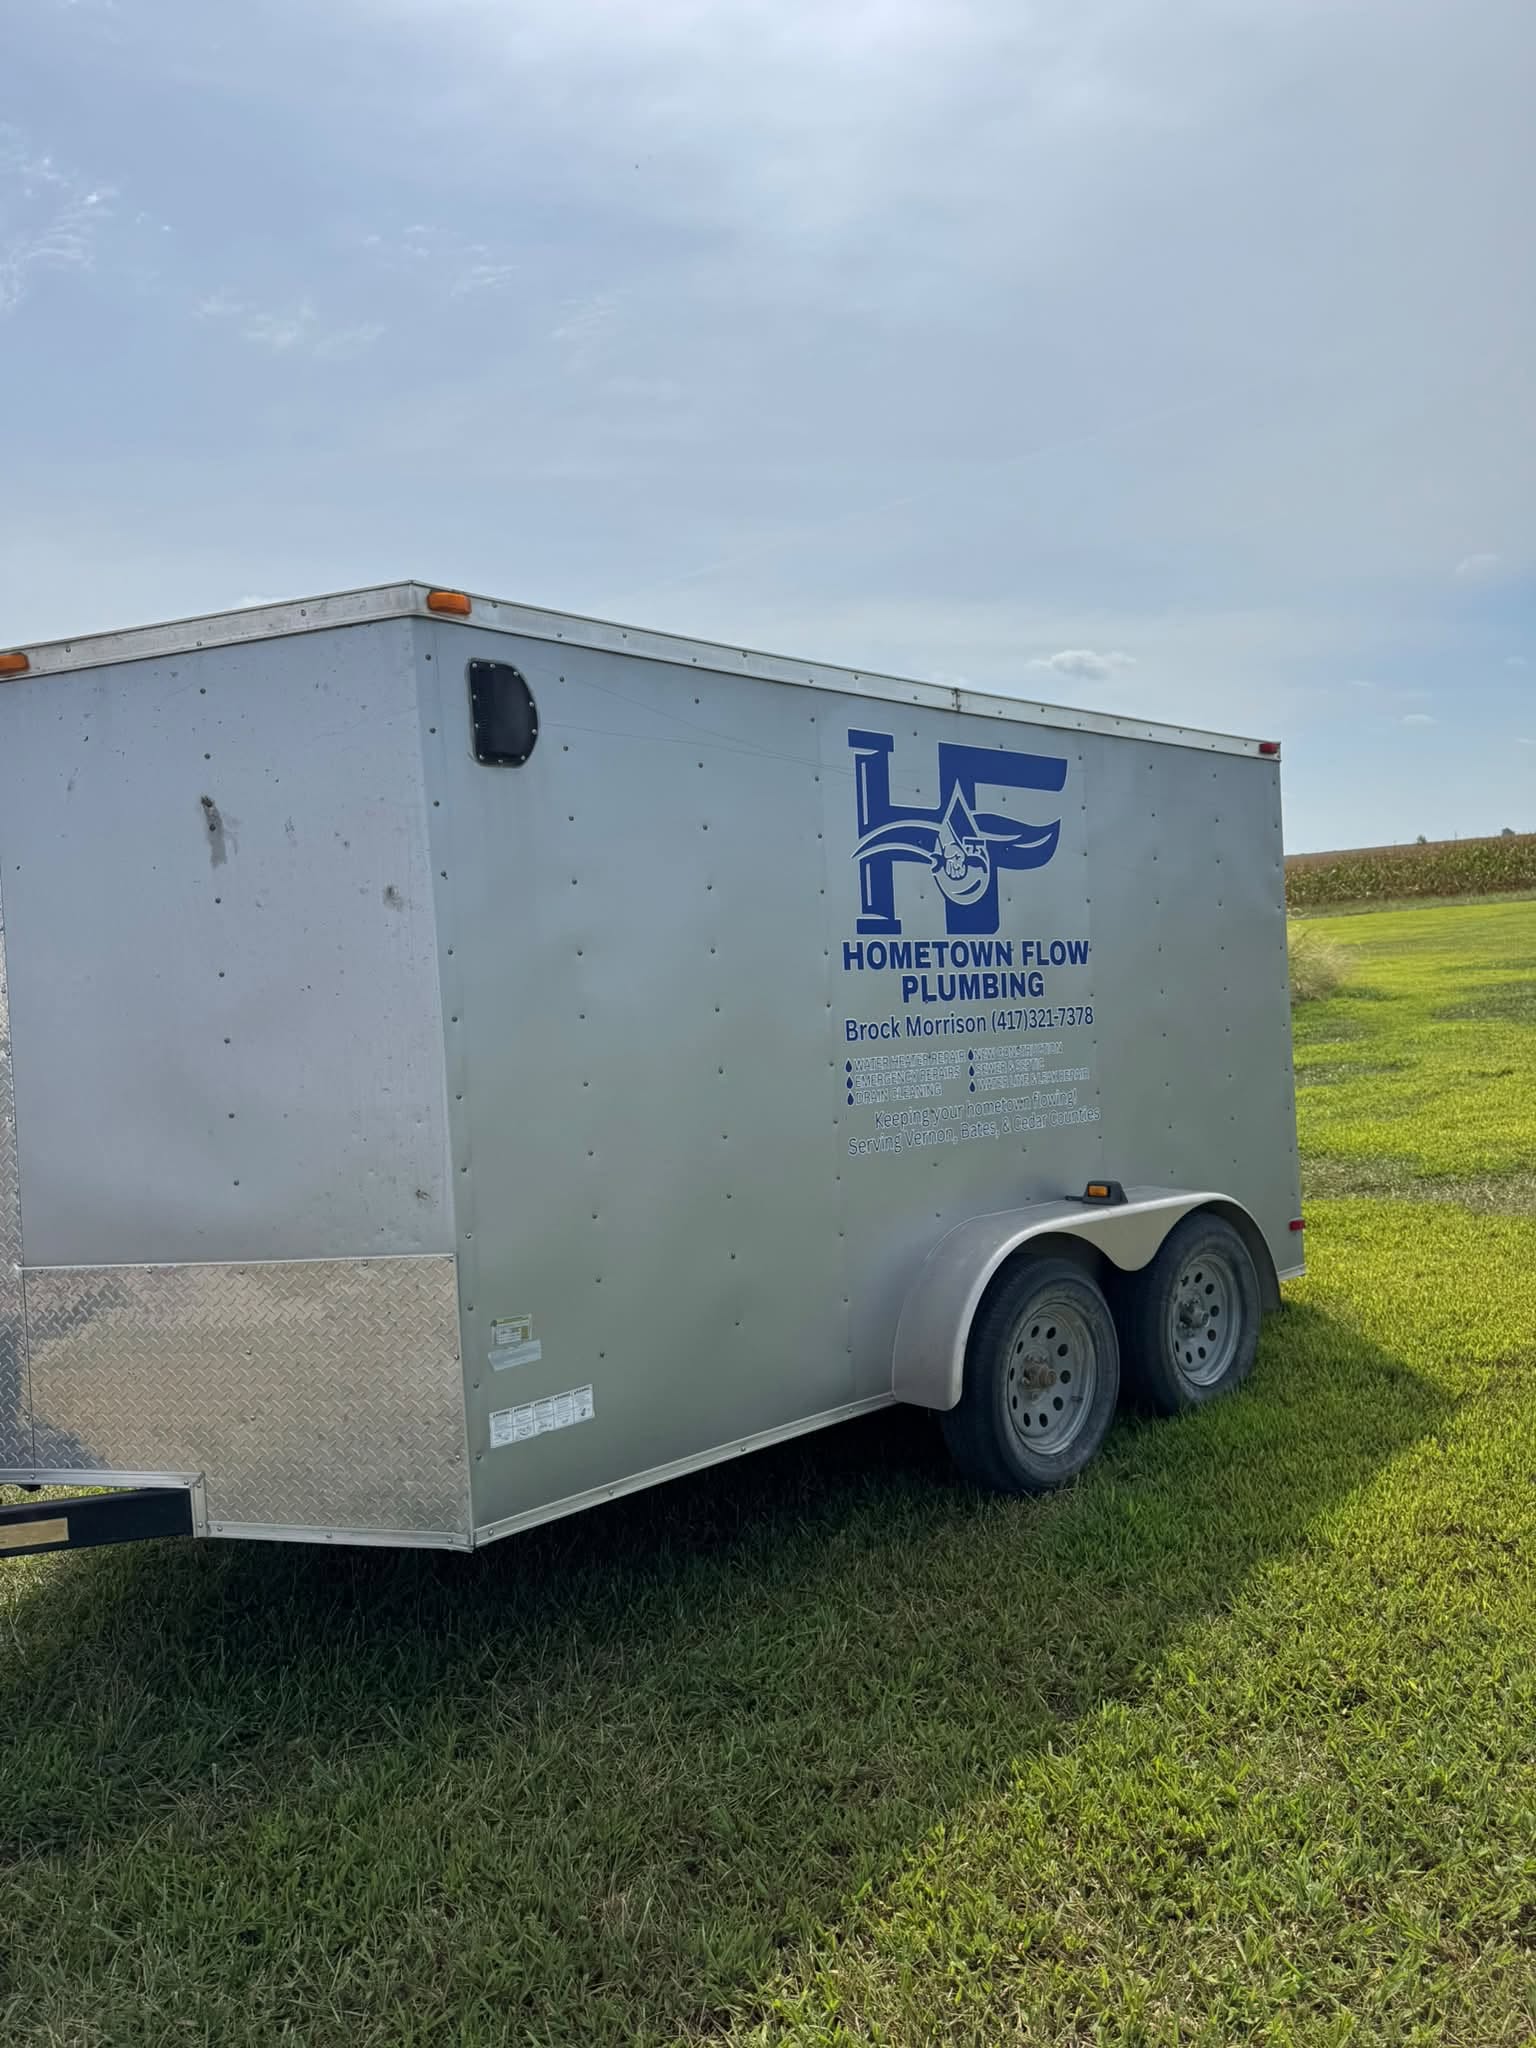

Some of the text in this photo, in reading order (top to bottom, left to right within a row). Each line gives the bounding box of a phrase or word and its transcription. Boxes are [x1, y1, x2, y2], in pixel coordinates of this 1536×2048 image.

[842, 939, 1089, 970] HOMETOWN FLOW
[902, 971, 1044, 1003] PLUMBING
[846, 1006, 1094, 1041] Brock Morrison (417)321-7378
[854, 1057, 889, 1072] WATER
[892, 1053, 929, 1068] HEATER
[855, 1066, 960, 1088] EMERGENCY REPAIRS
[855, 1083, 943, 1105] DRAIN CLEANING
[874, 1107, 930, 1129] Keeping
[932, 1105, 963, 1125] your
[967, 1098, 1029, 1117] hometown
[848, 1105, 1100, 1156] Serving Vernon, Bates, & Cedar Counties
